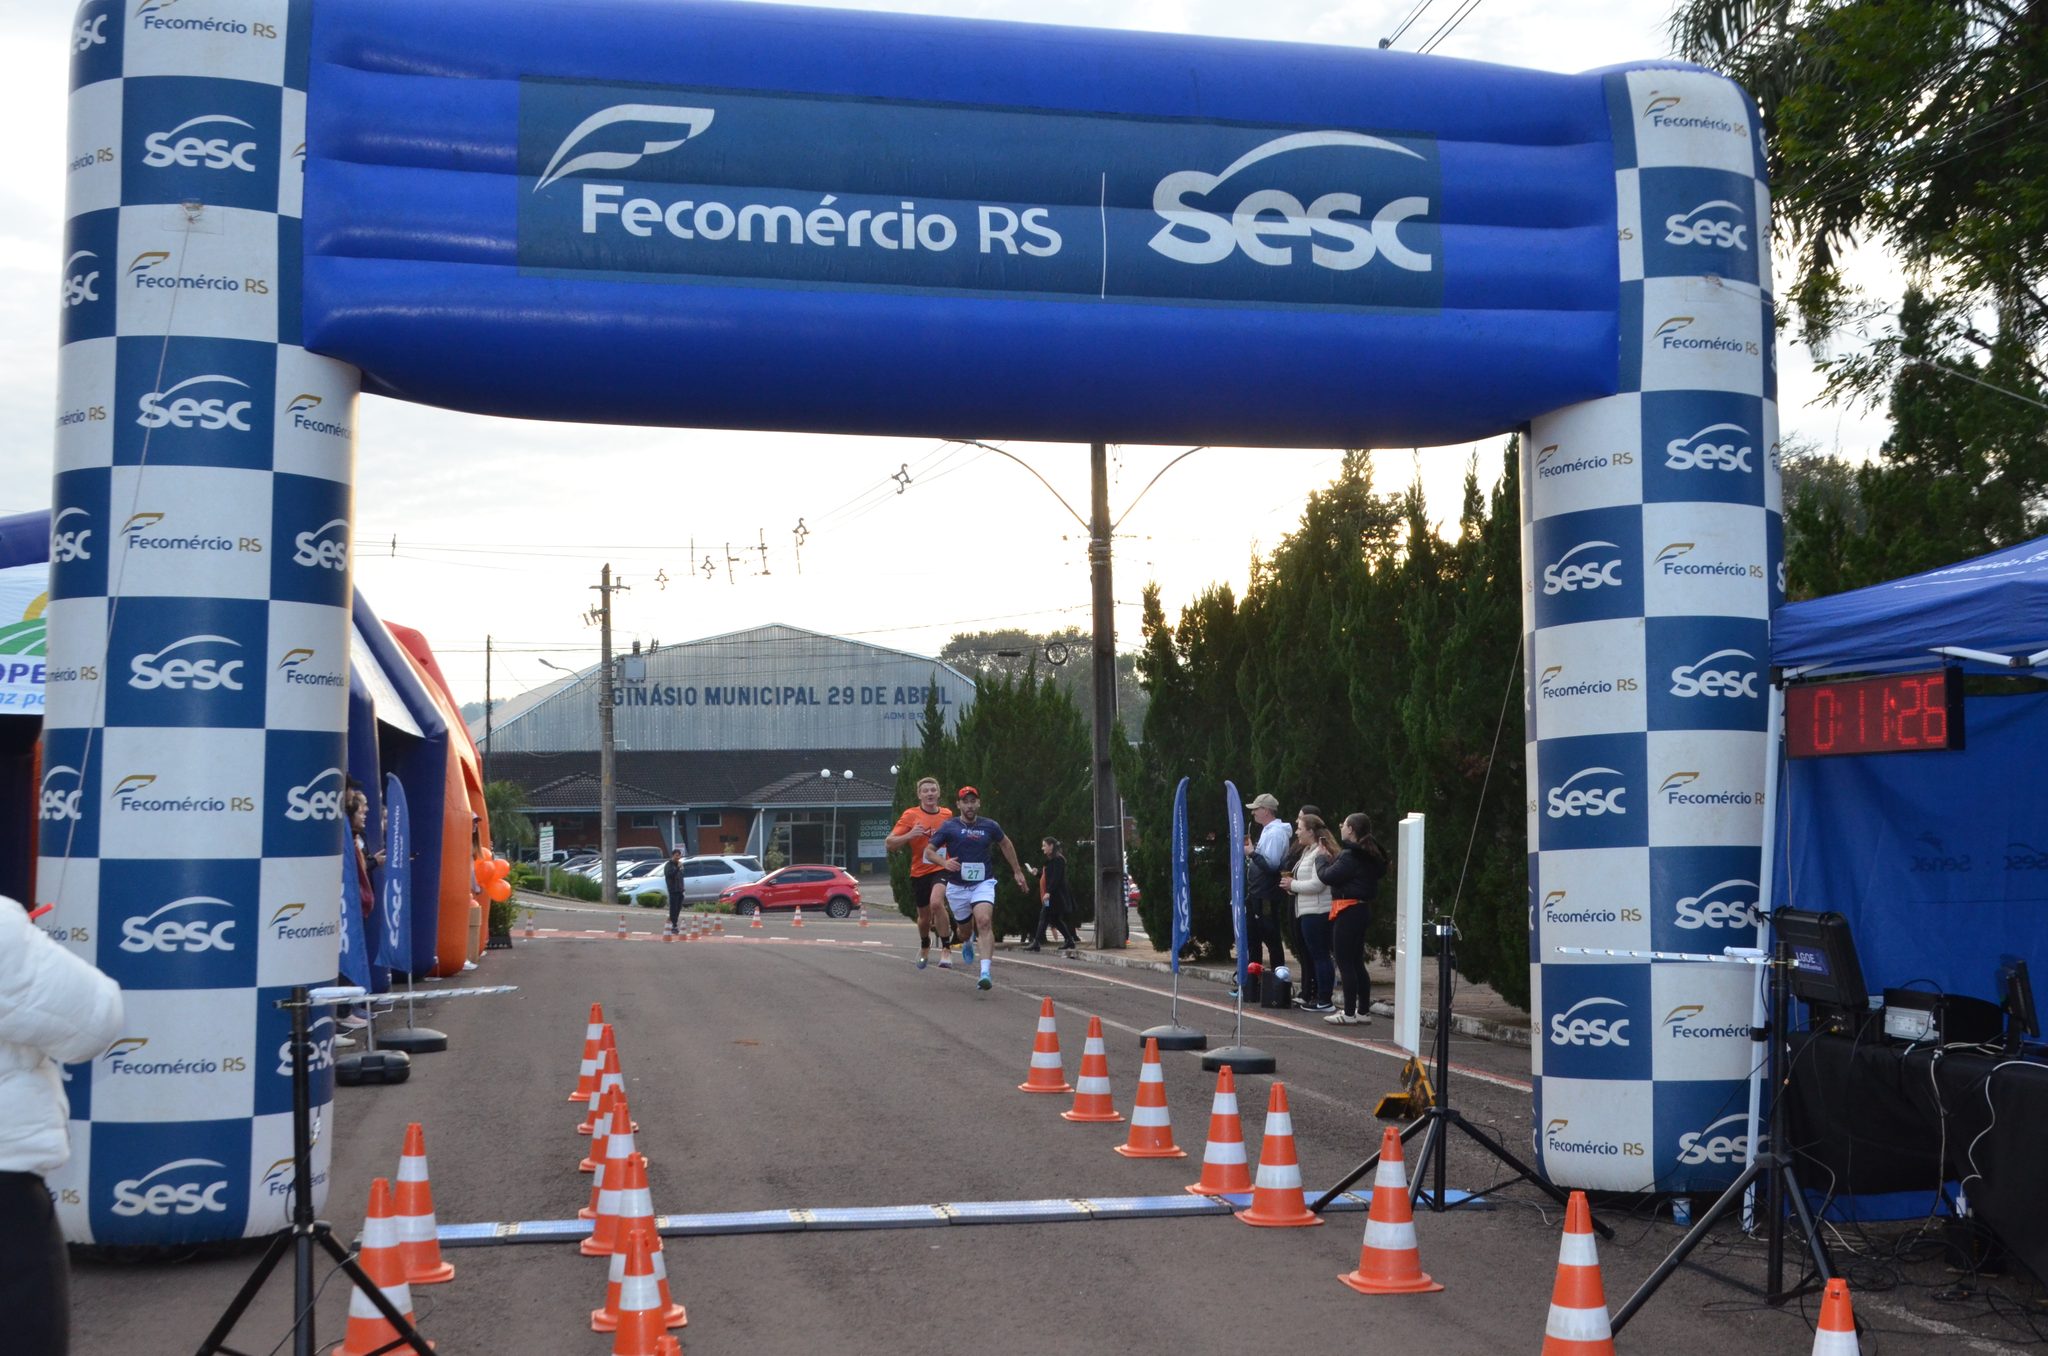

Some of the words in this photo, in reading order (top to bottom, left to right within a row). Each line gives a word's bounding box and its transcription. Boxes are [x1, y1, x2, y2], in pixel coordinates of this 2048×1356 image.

[144, 15, 247, 35] Fecomércio
[253, 22, 278, 39] RS
[1653, 114, 1732, 133] Fecomércio
[142, 114, 257, 172] Sesc
[97, 148, 114, 162] RS
[1147, 130, 1433, 272] Sesc
[582, 184, 957, 252] Fecomércio
[978, 205, 1063, 257] RS
[1664, 200, 1748, 251] Sesc
[136, 273, 239, 291] Fecomércio
[245, 278, 269, 295] RS
[1663, 336, 1742, 353] Fecomércio
[88, 406, 106, 421] RS
[136, 374, 251, 431] Sesc
[1664, 423, 1752, 473] Sesc
[1539, 457, 1608, 479] Fecomércio
[1612, 452, 1633, 466] RS
[51, 507, 92, 563] esc
[129, 534, 233, 551] Fecomércio
[239, 537, 263, 553] RS
[1543, 540, 1622, 595] Sesc
[1664, 560, 1746, 577] Fecomércio
[1749, 564, 1764, 579] RS
[80, 665, 98, 681] RS
[127, 634, 244, 691] Sesc
[1669, 649, 1758, 698] Sesc
[613, 683, 697, 706] GINÁSIO
[704, 686, 821, 706] MUNICIPAL
[828, 686, 854, 705] 29
[861, 686, 887, 705] DE
[894, 686, 952, 705] ABRIL
[1543, 681, 1612, 699] Fecomércio
[1616, 678, 1638, 692] RS
[1813, 675, 1947, 751] 0:11:26
[1547, 767, 1626, 818] Sesc
[1669, 790, 1751, 804] Fecomércio
[121, 796, 225, 813] Fecomércio
[230, 796, 254, 812] RS
[968, 869, 979, 880] 27
[118, 896, 235, 953] Sesc
[1547, 909, 1616, 923] Fecomércio
[1621, 908, 1642, 922] RS
[70, 928, 89, 942] RS
[1551, 997, 1630, 1047] Sesc
[1672, 1023, 1752, 1038] Fecomérci
[112, 1058, 216, 1075] Fecomércio
[223, 1057, 246, 1072] RS
[1549, 1137, 1618, 1155] Fecomércio
[1623, 1142, 1645, 1156] RS
[62, 1188, 80, 1204] RS
[111, 1158, 228, 1217] Sesc
